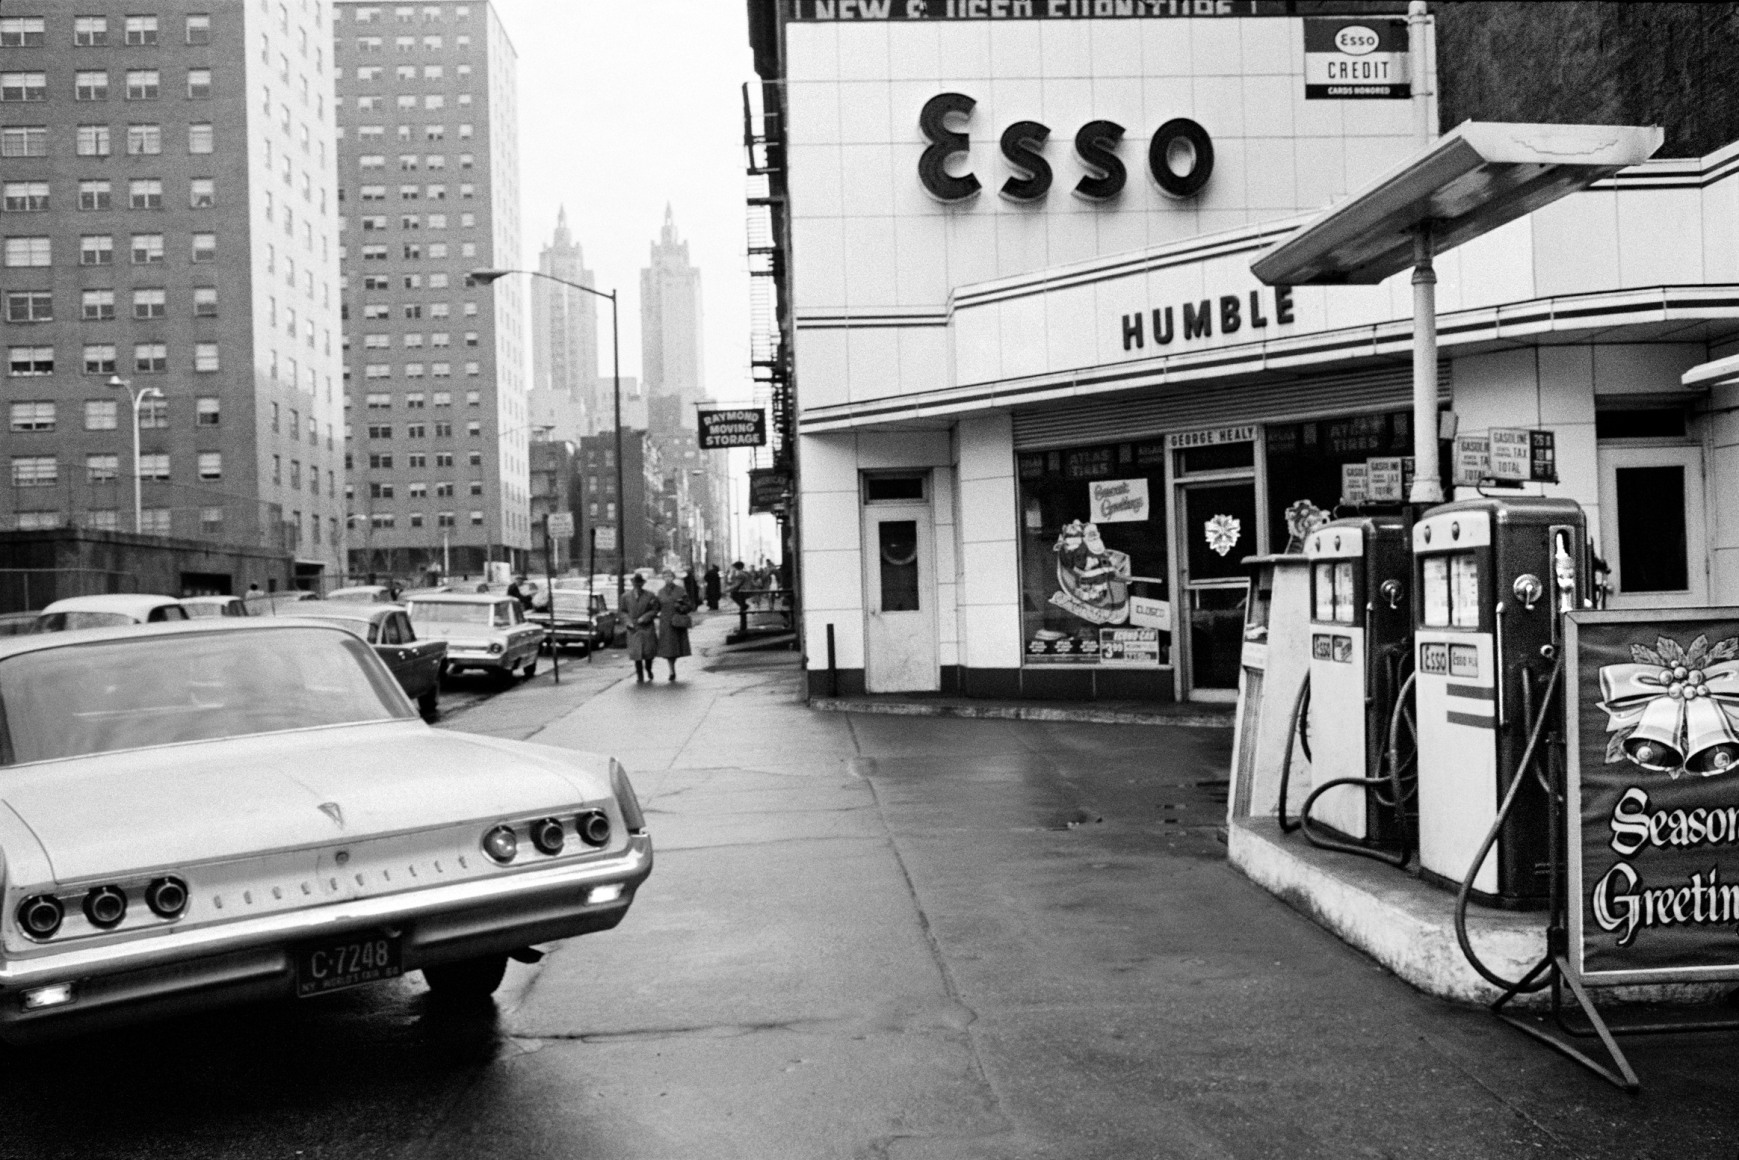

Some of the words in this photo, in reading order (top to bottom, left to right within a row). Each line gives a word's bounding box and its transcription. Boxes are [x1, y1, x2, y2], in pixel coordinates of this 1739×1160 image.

[1328, 61, 1389, 79] CREDIT
[1121, 285, 1296, 351] HUMBLE
[703, 411, 759, 426] RAYMOND
[709, 422, 755, 435] MOVING
[705, 433, 760, 446] STORAGE
[1171, 431, 1213, 447] GEORGE
[1219, 427, 1254, 442] HEALY
[1493, 431, 1528, 446] GASOLINE
[1498, 461, 1521, 474] TOTAL
